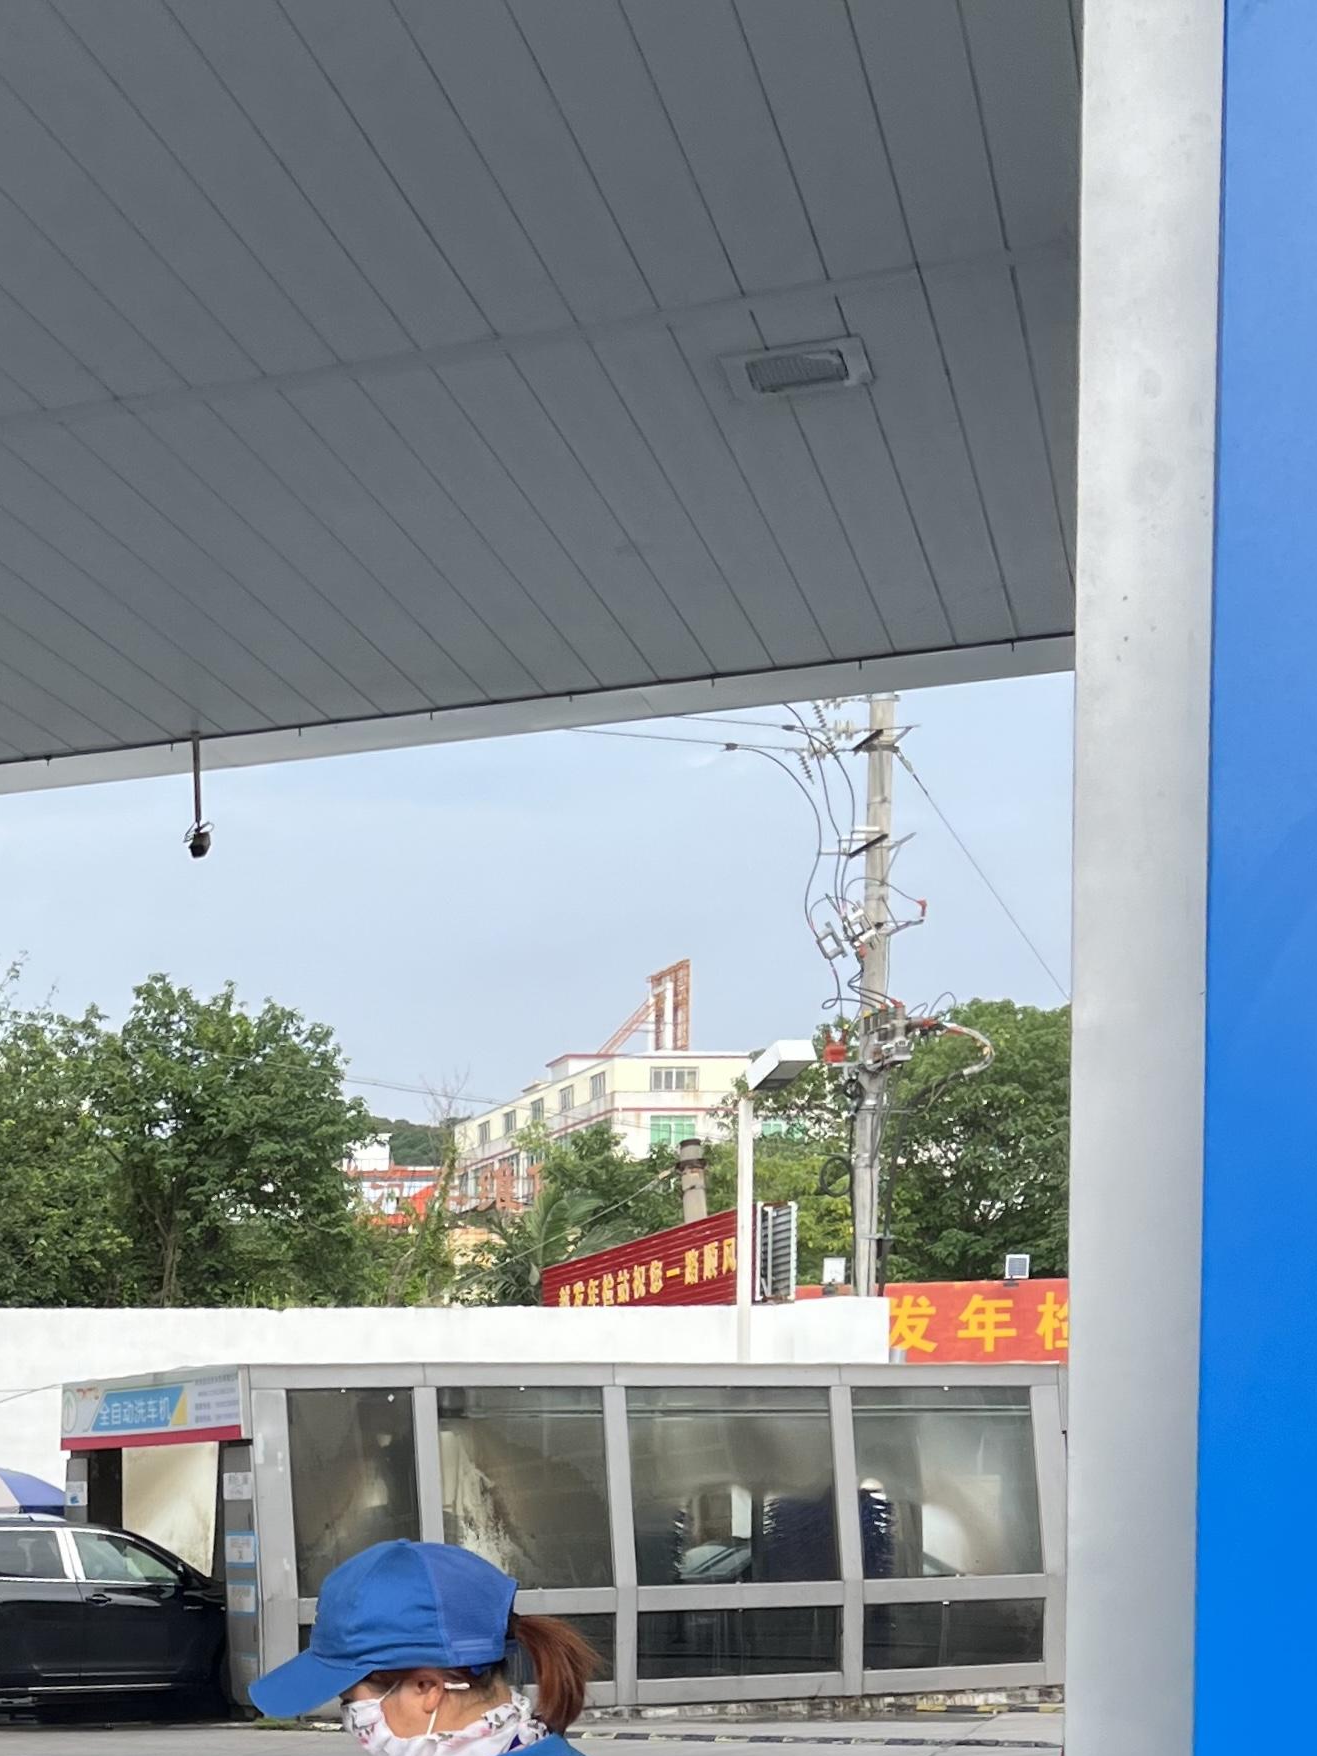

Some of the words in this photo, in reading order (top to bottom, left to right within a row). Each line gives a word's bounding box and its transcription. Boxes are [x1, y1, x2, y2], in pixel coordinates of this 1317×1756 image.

[99, 1397, 171, 1426] 全自动洗车机
